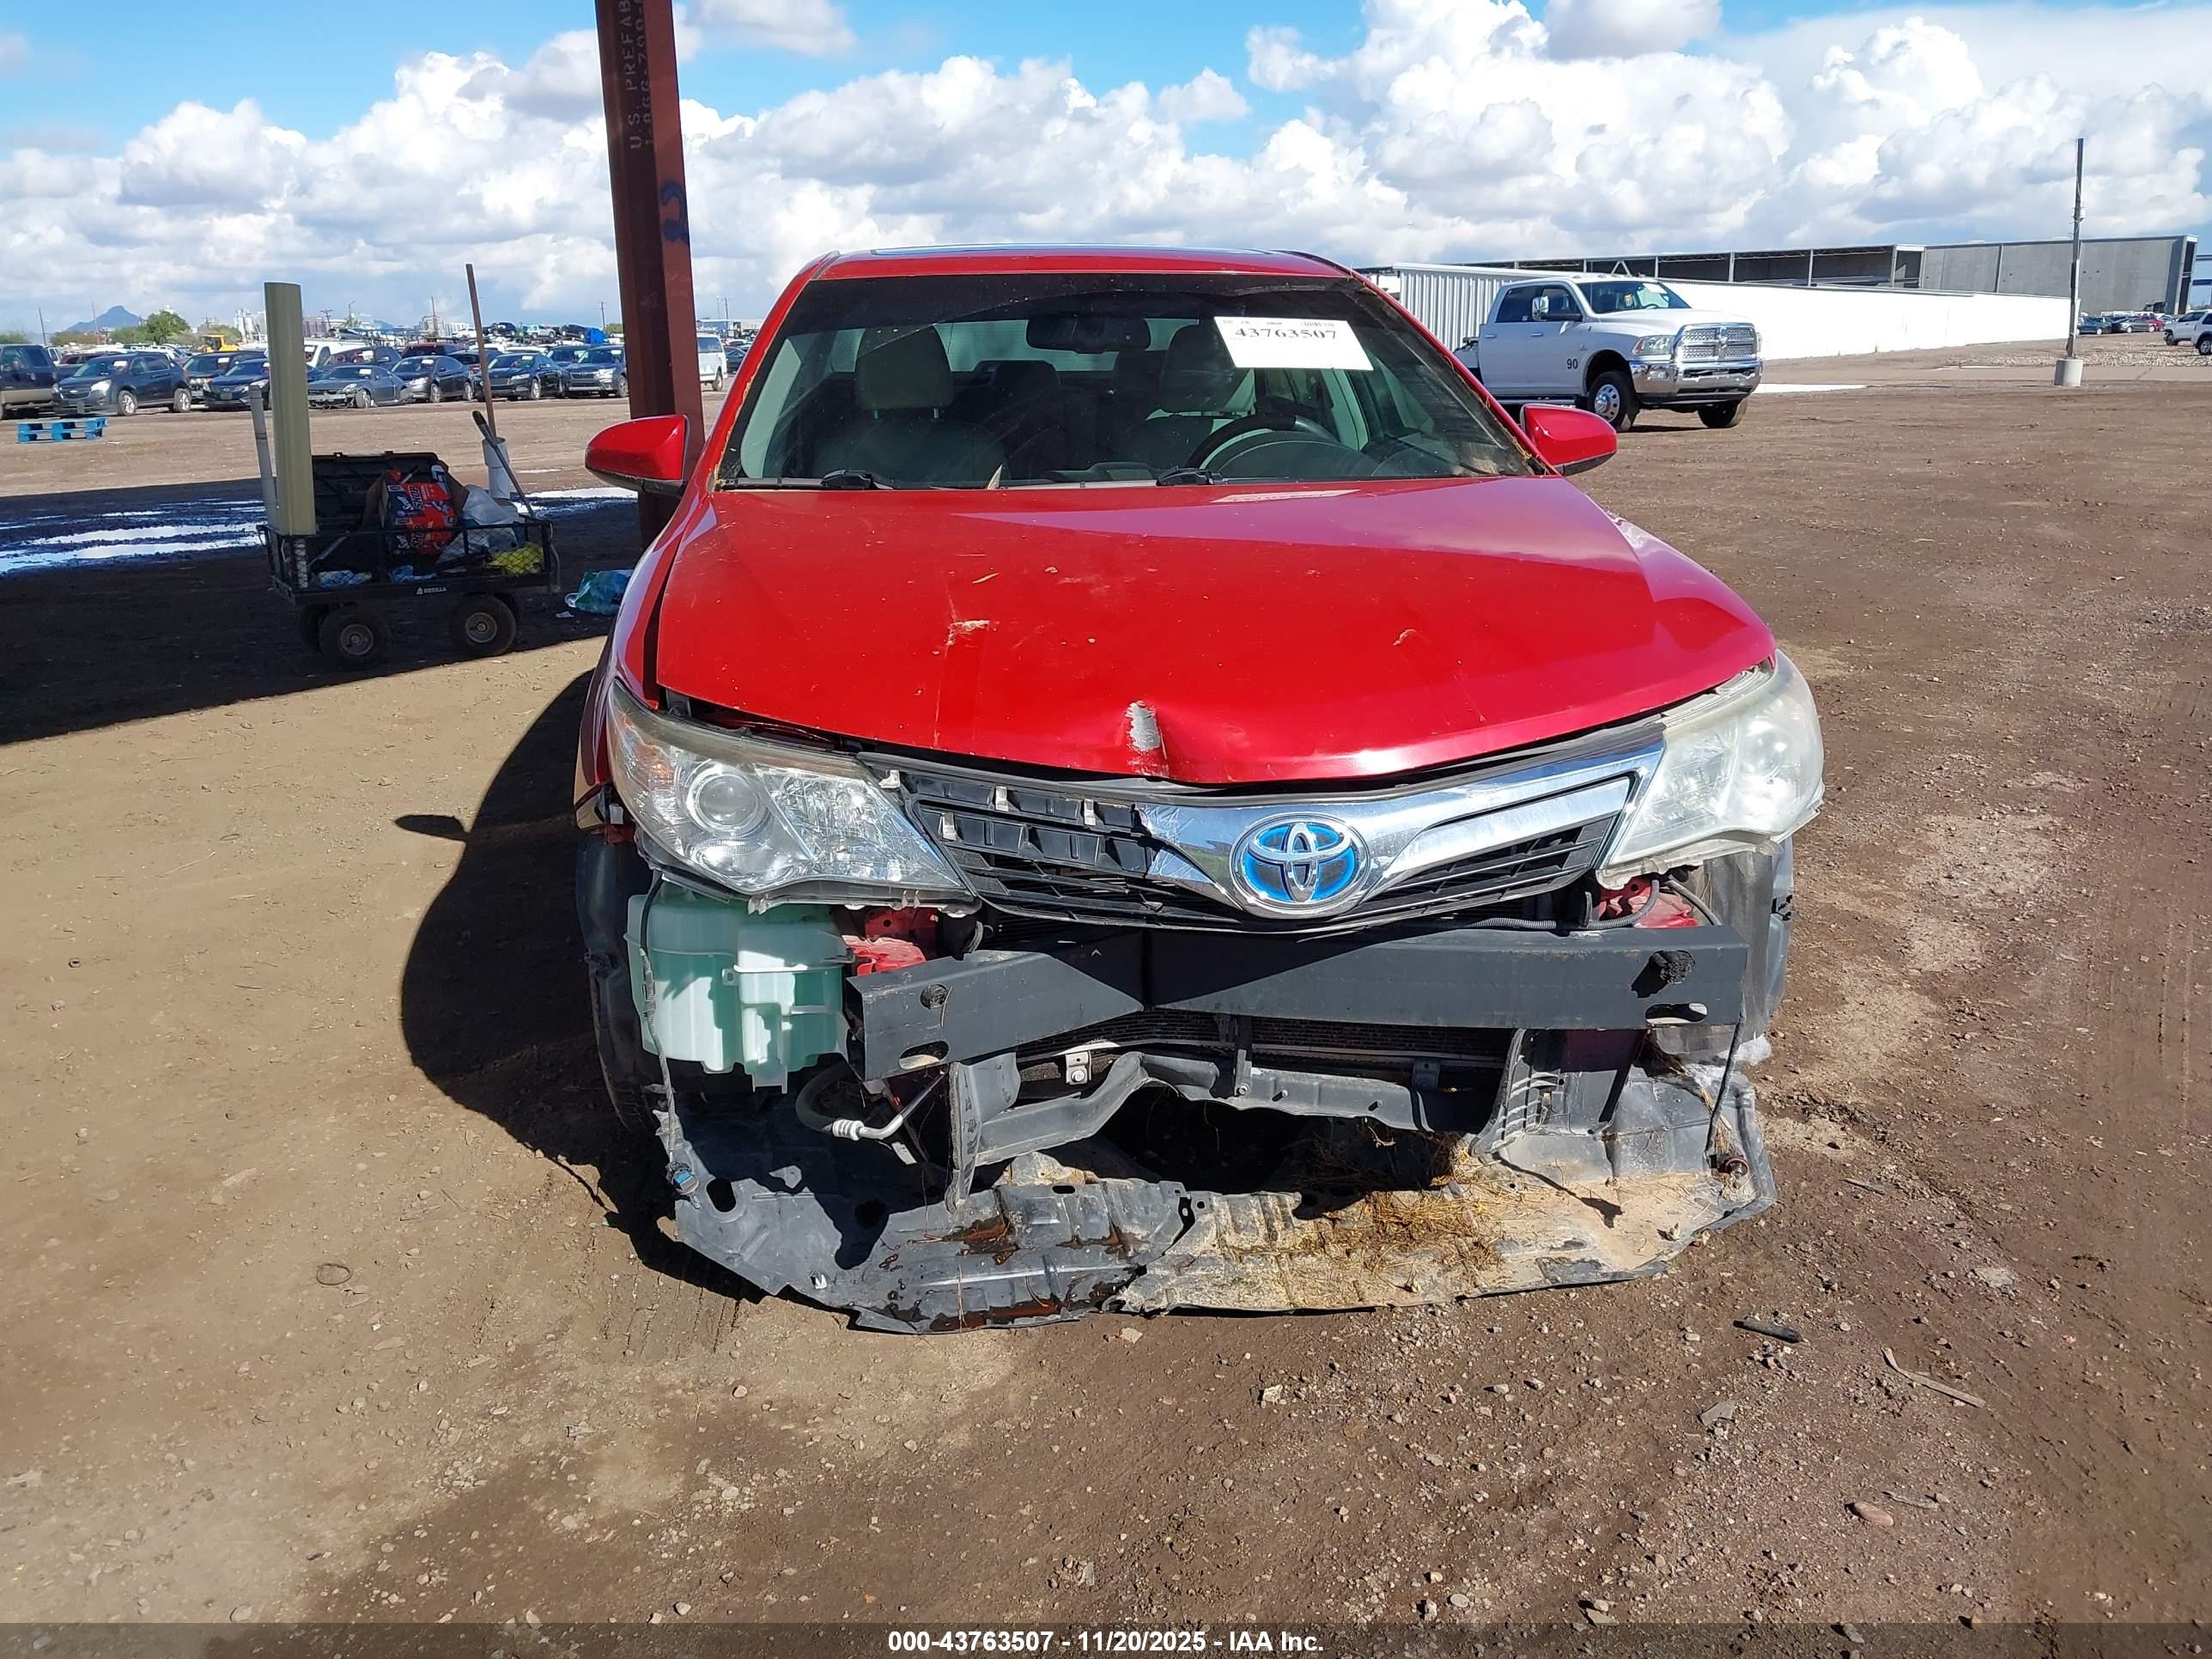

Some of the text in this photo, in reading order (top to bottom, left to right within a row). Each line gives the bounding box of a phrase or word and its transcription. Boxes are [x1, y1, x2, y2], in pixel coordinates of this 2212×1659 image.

[628, 105, 642, 150] U.S.
[1235, 328, 1336, 339] 43763507
[1566, 358, 1578, 369] 90
[407, 484, 424, 509] SHOP
